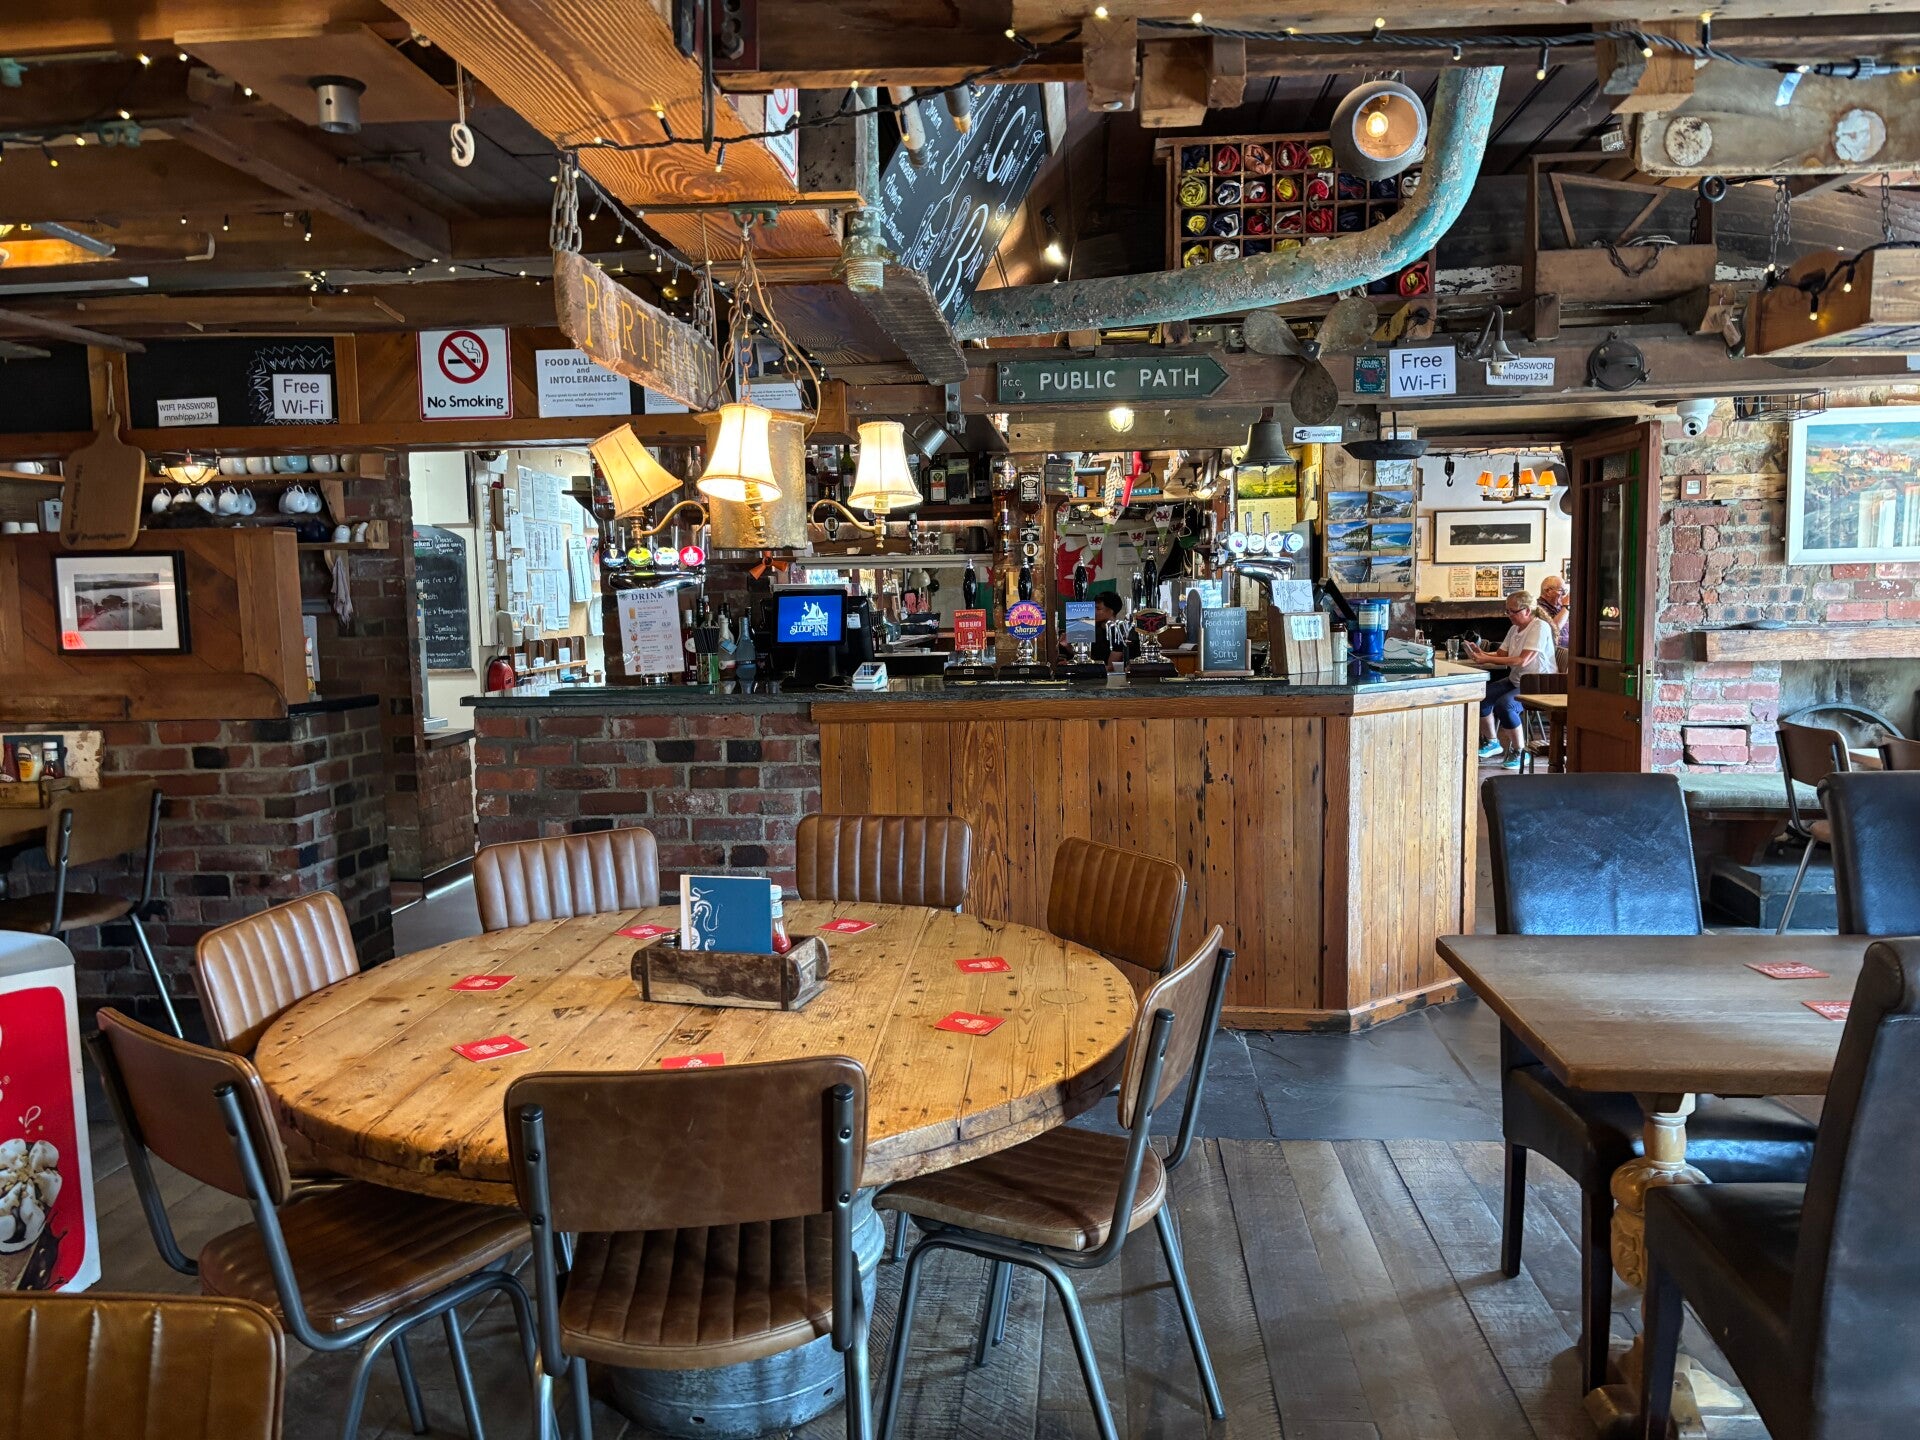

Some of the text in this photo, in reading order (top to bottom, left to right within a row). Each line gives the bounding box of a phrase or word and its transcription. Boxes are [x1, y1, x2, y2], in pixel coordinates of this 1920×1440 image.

[545, 358, 570, 366] FOOD
[1401, 353, 1442, 369] Free
[1508, 362, 1554, 370] PASSWORD
[549, 375, 618, 384] INTOLERANCES
[1039, 367, 1199, 391] PUBLIC PATH
[1400, 374, 1447, 391] Wi-Fi
[283, 378, 320, 394] Free
[177, 402, 216, 411] PASSWORD
[427, 394, 504, 410] No Smoking
[282, 400, 324, 415] Wi-Fi
[631, 592, 664, 600] DRINK
[1010, 606, 1026, 619] SOLAR
[1203, 610, 1225, 619] Please
[1205, 620, 1221, 628] food
[790, 625, 814, 635] SLOOP
[1213, 650, 1238, 660] Sorry
